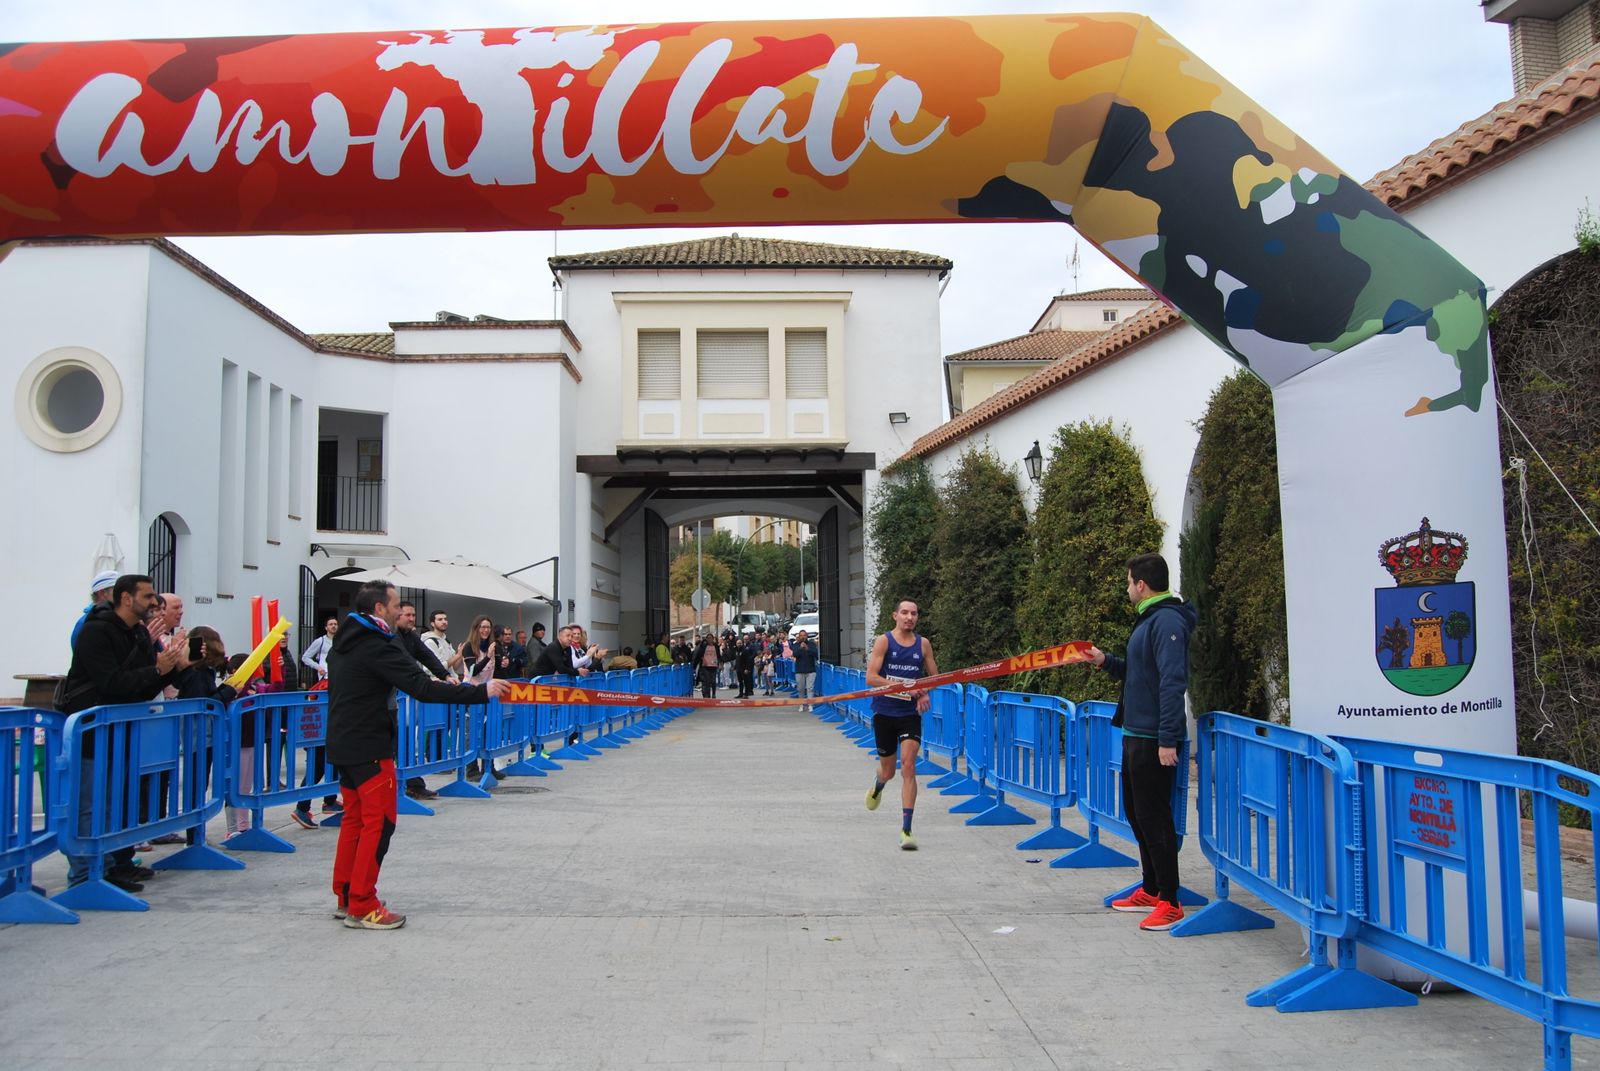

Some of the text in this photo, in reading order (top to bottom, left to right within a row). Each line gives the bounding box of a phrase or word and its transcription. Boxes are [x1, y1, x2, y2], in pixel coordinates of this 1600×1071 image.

[1009, 643, 1082, 671] META
[510, 683, 589, 703] META
[1337, 697, 1503, 719] Ayuntamiento de Montilla
[1439, 797, 1454, 816] DE
[1408, 807, 1457, 833] MONTILLA
